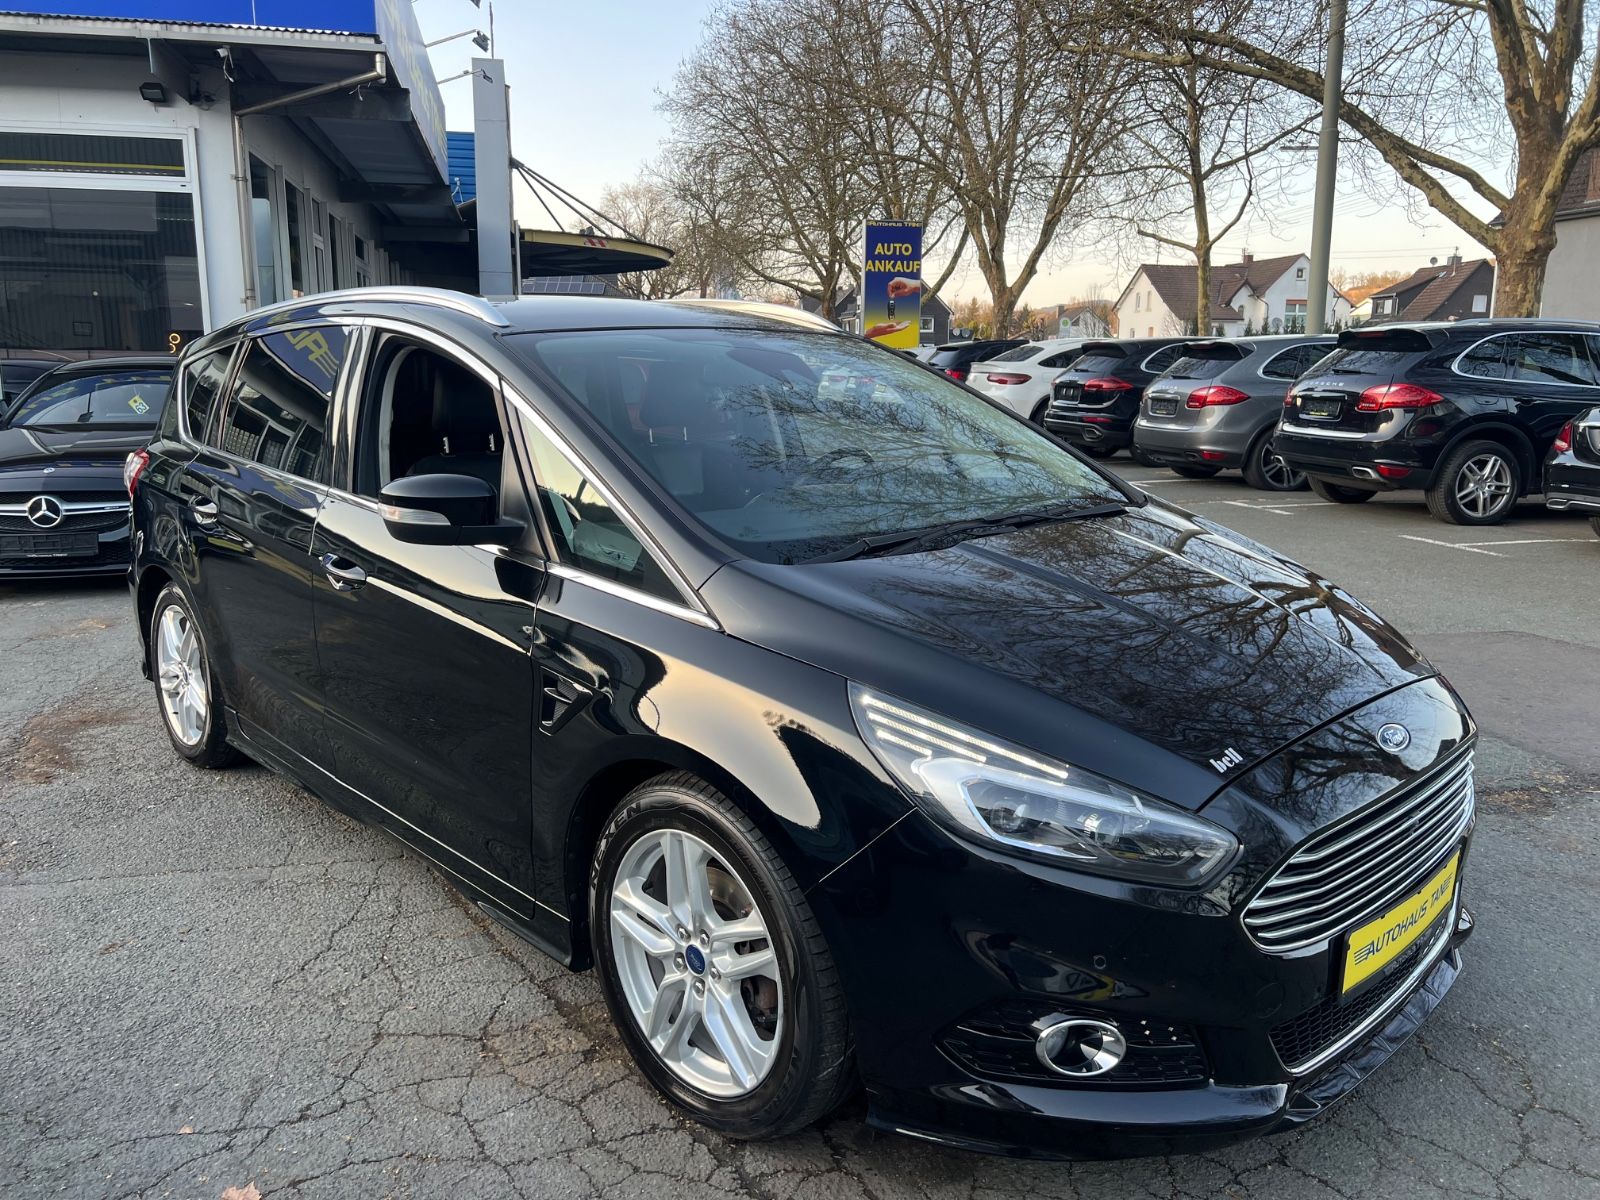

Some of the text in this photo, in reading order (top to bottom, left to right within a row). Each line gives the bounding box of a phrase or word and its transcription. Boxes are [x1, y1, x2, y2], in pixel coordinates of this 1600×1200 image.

[875, 243, 912, 255] AUTO
[866, 260, 920, 273] ANKAUF
[1209, 747, 1243, 773] bell
[591, 801, 641, 888] NEXEN
[1362, 899, 1429, 957] AUTOHAUS
